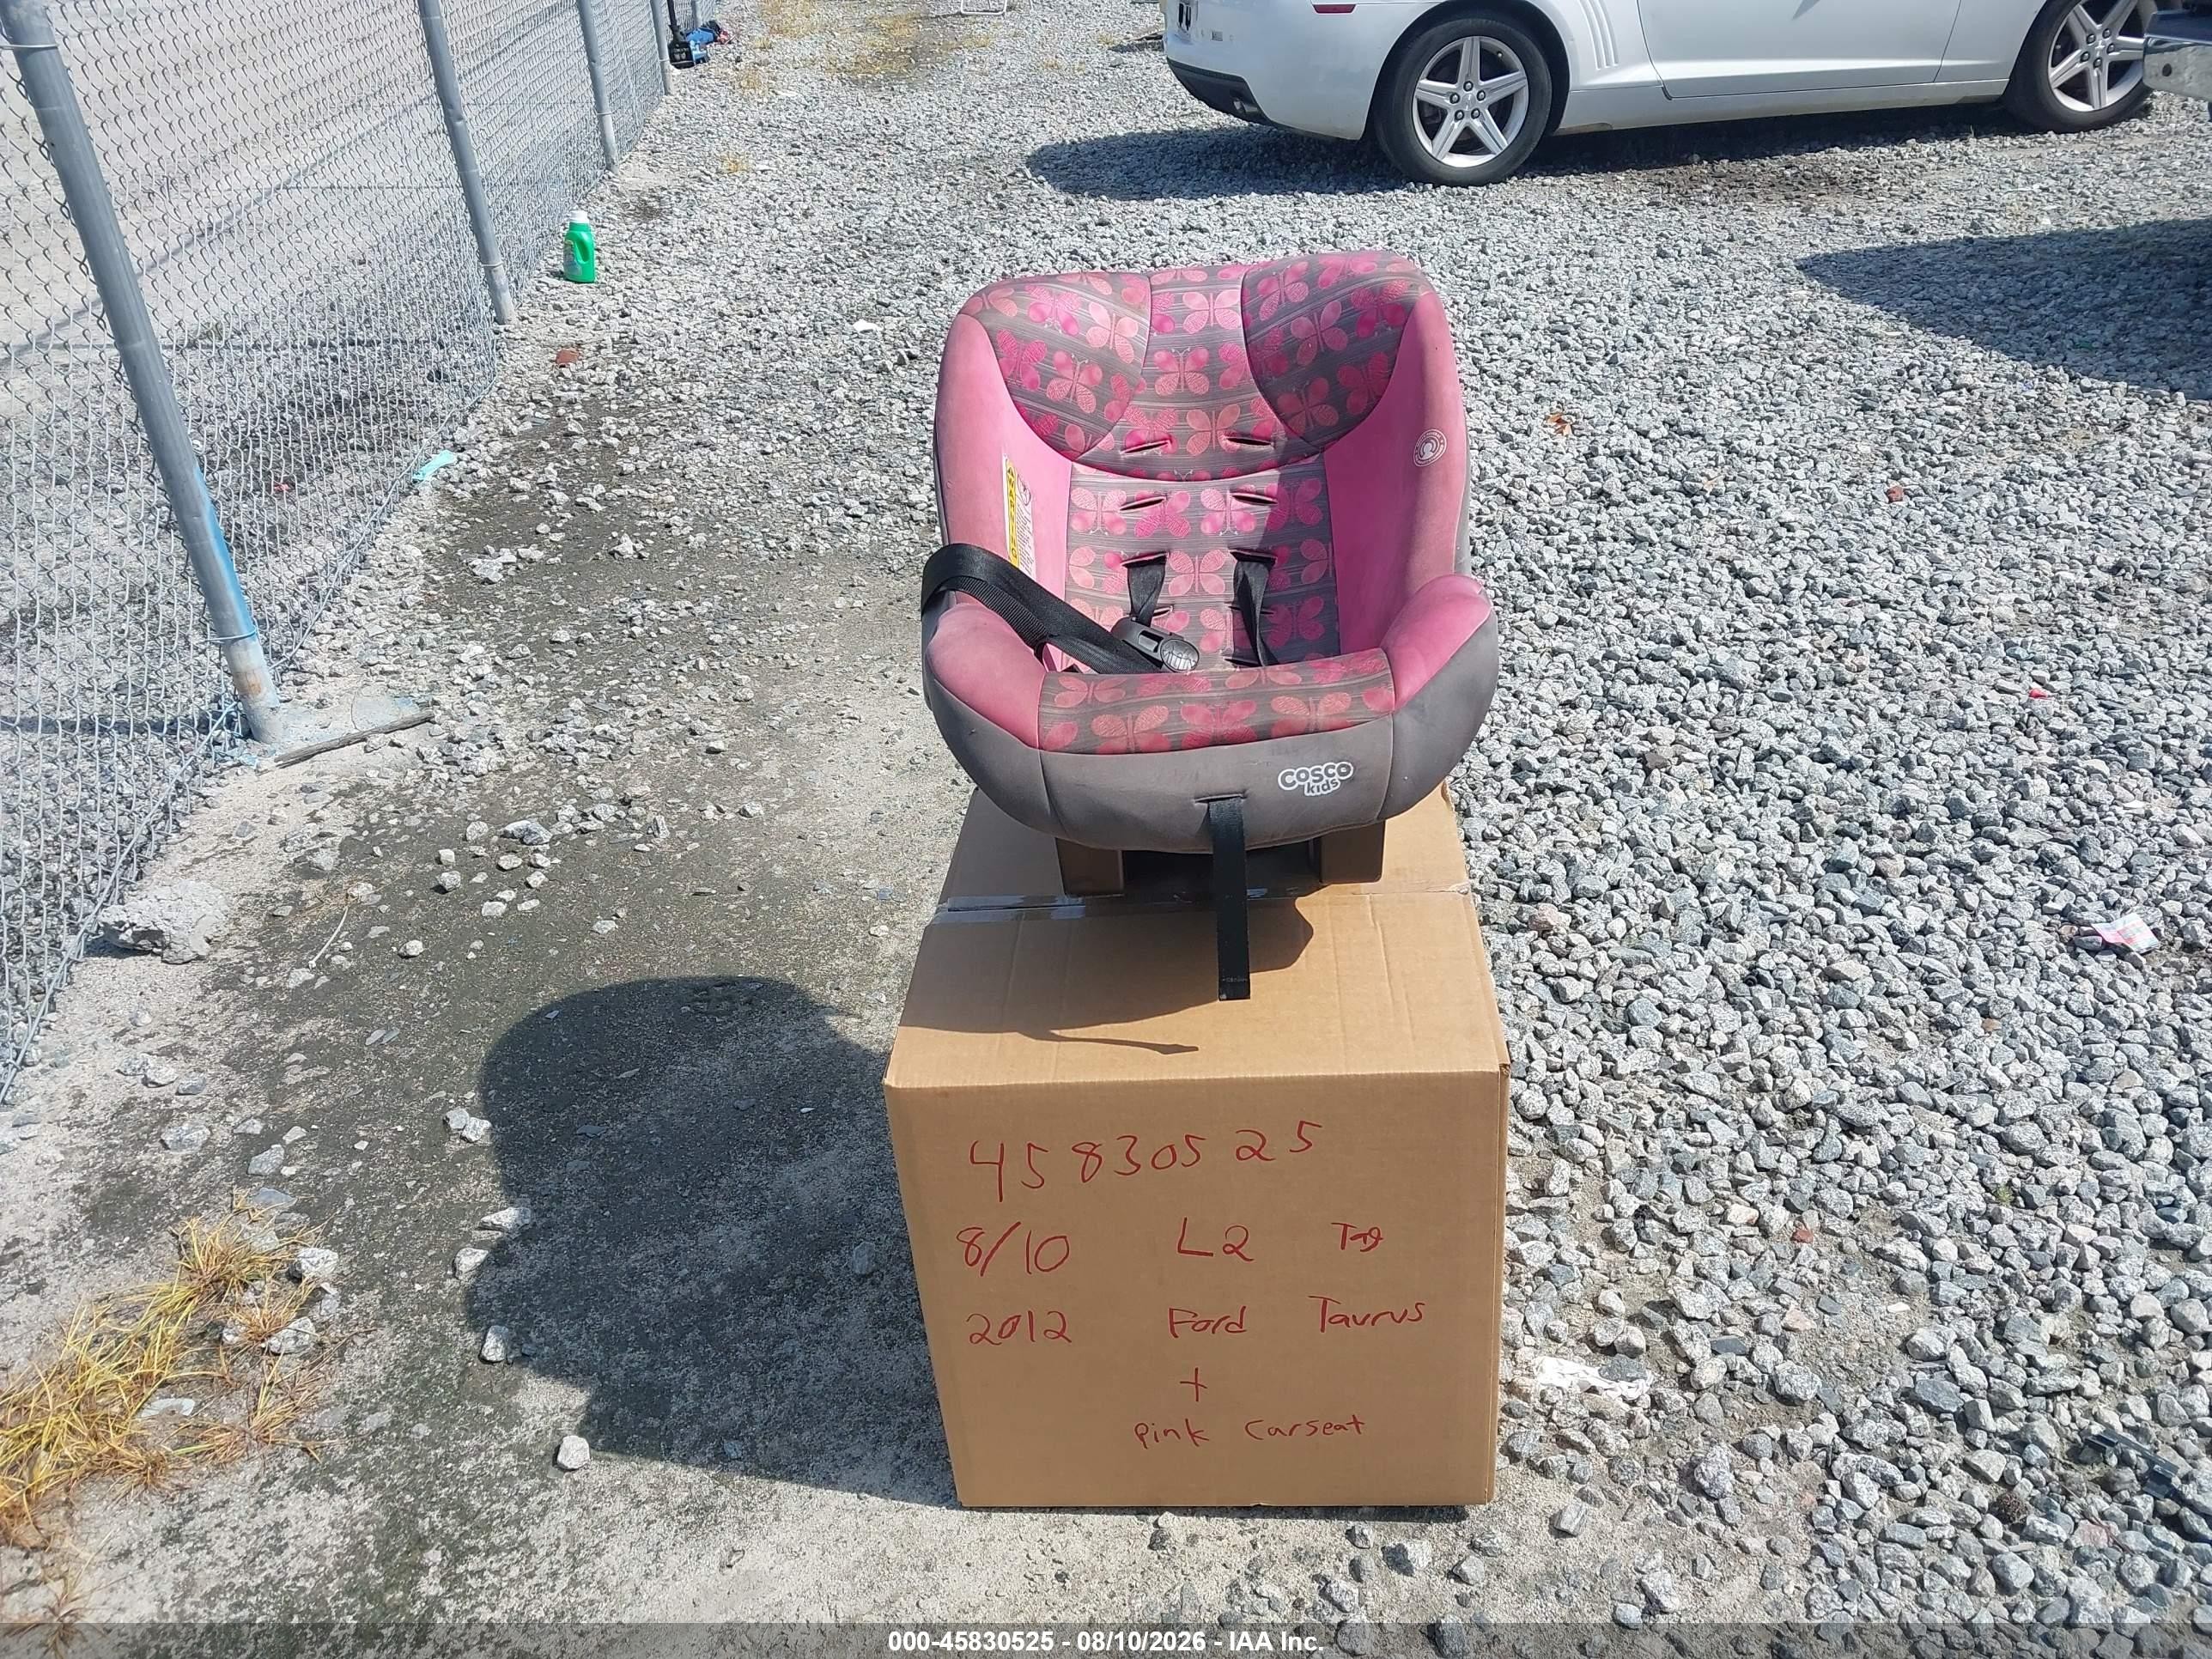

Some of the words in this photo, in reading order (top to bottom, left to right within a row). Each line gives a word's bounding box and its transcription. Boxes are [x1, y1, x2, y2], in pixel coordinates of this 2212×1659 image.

[1007, 478, 1018, 558] WARNING
[1304, 778, 1340, 796] kids
[957, 1221, 1071, 1277] 8/10
[1176, 1217, 1255, 1262] L2
[969, 1309, 1073, 1346] 2012
[1169, 1305, 1248, 1338] Ford
[1308, 1295, 1427, 1334] Taurus
[1180, 1367, 1207, 1402] +
